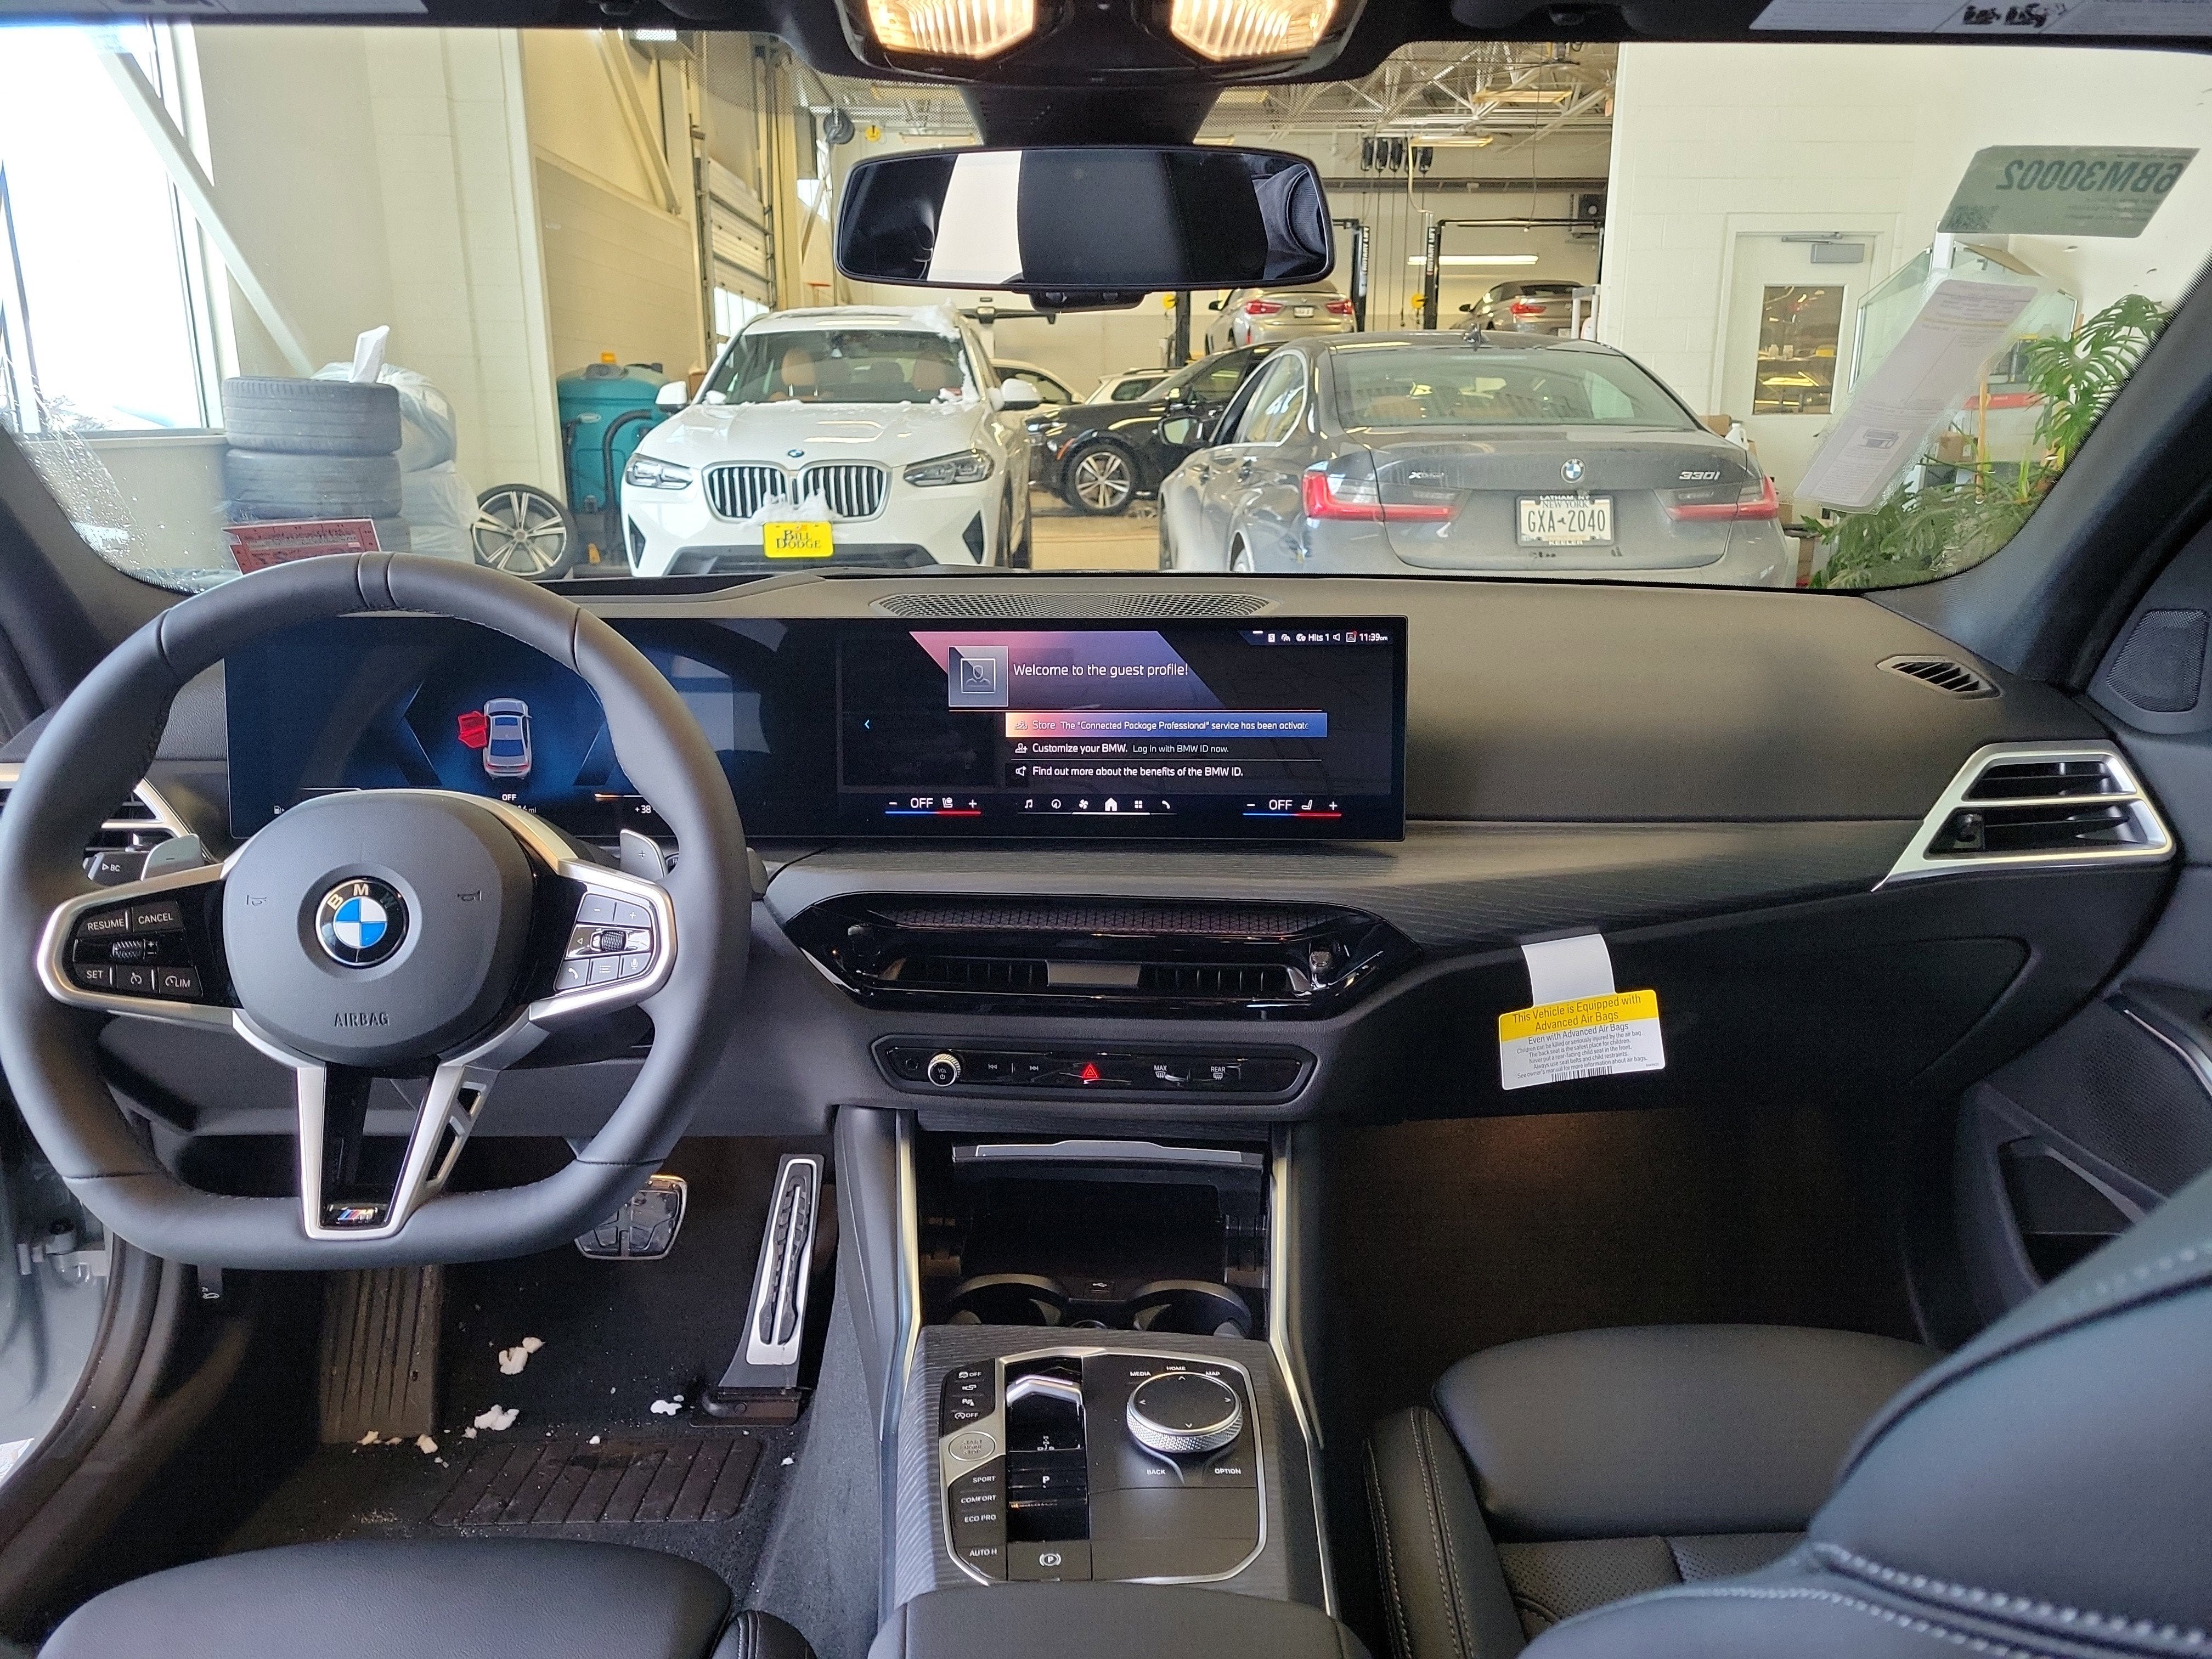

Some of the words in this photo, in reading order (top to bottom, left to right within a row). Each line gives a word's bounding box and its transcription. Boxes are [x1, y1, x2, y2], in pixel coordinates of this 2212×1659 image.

[1542, 500, 1561, 509] NEW
[1565, 500, 1590, 509] YORK
[776, 538, 822, 549] DODGE
[1308, 633, 1323, 641] Hits
[1013, 663, 1068, 676] Welcome
[1072, 664, 1084, 675] to
[1087, 664, 1107, 675] the
[1110, 664, 1144, 678] guest
[1147, 663, 1188, 678] profile!
[1032, 720, 1056, 730] Store
[1060, 721, 1075, 730] The
[1077, 721, 1121, 730] "Connected
[1125, 721, 1157, 731] Package
[1032, 743, 1078, 753] Customize
[1080, 745, 1100, 754] your
[1102, 744, 1127, 753] BMW.
[1133, 745, 1147, 754] Log
[1032, 767, 1052, 776] Find
[1054, 768, 1069, 776] out
[1096, 768, 1121, 776] about
[1124, 768, 1138, 776] the
[1140, 767, 1175, 776] benefits
[1177, 767, 1188, 776] of
[1190, 767, 1203, 776] the
[1205, 768, 1229, 776] BMW
[1232, 768, 1243, 776] ID.
[910, 798, 933, 808] OFF
[1269, 799, 1293, 810] OFF
[110, 864, 121, 872] BC
[138, 912, 174, 924] CANCEL
[87, 918, 125, 931] RESUME
[86, 970, 104, 979] SET
[175, 978, 190, 988] LIM
[1513, 1013, 1531, 1024] This
[1533, 1006, 1565, 1019] Vehicle
[1567, 1005, 1574, 1013] is
[1577, 996, 1619, 1012] Equipped
[1622, 994, 1641, 1005] with
[334, 1012, 390, 1027] AIRBAG
[1535, 1015, 1578, 1031] Advanced
[1581, 1014, 1593, 1024] Air
[1596, 1012, 1618, 1022] Bags
[1528, 1036, 1545, 1045] Even
[1547, 1032, 1561, 1041] with
[1562, 1026, 1597, 1039] Advanced
[1599, 1025, 1609, 1033] Air
[1611, 1024, 1628, 1032] Bags
[1527, 1068, 1545, 1076] owner's
[961, 1495, 997, 1504] COMFORT
